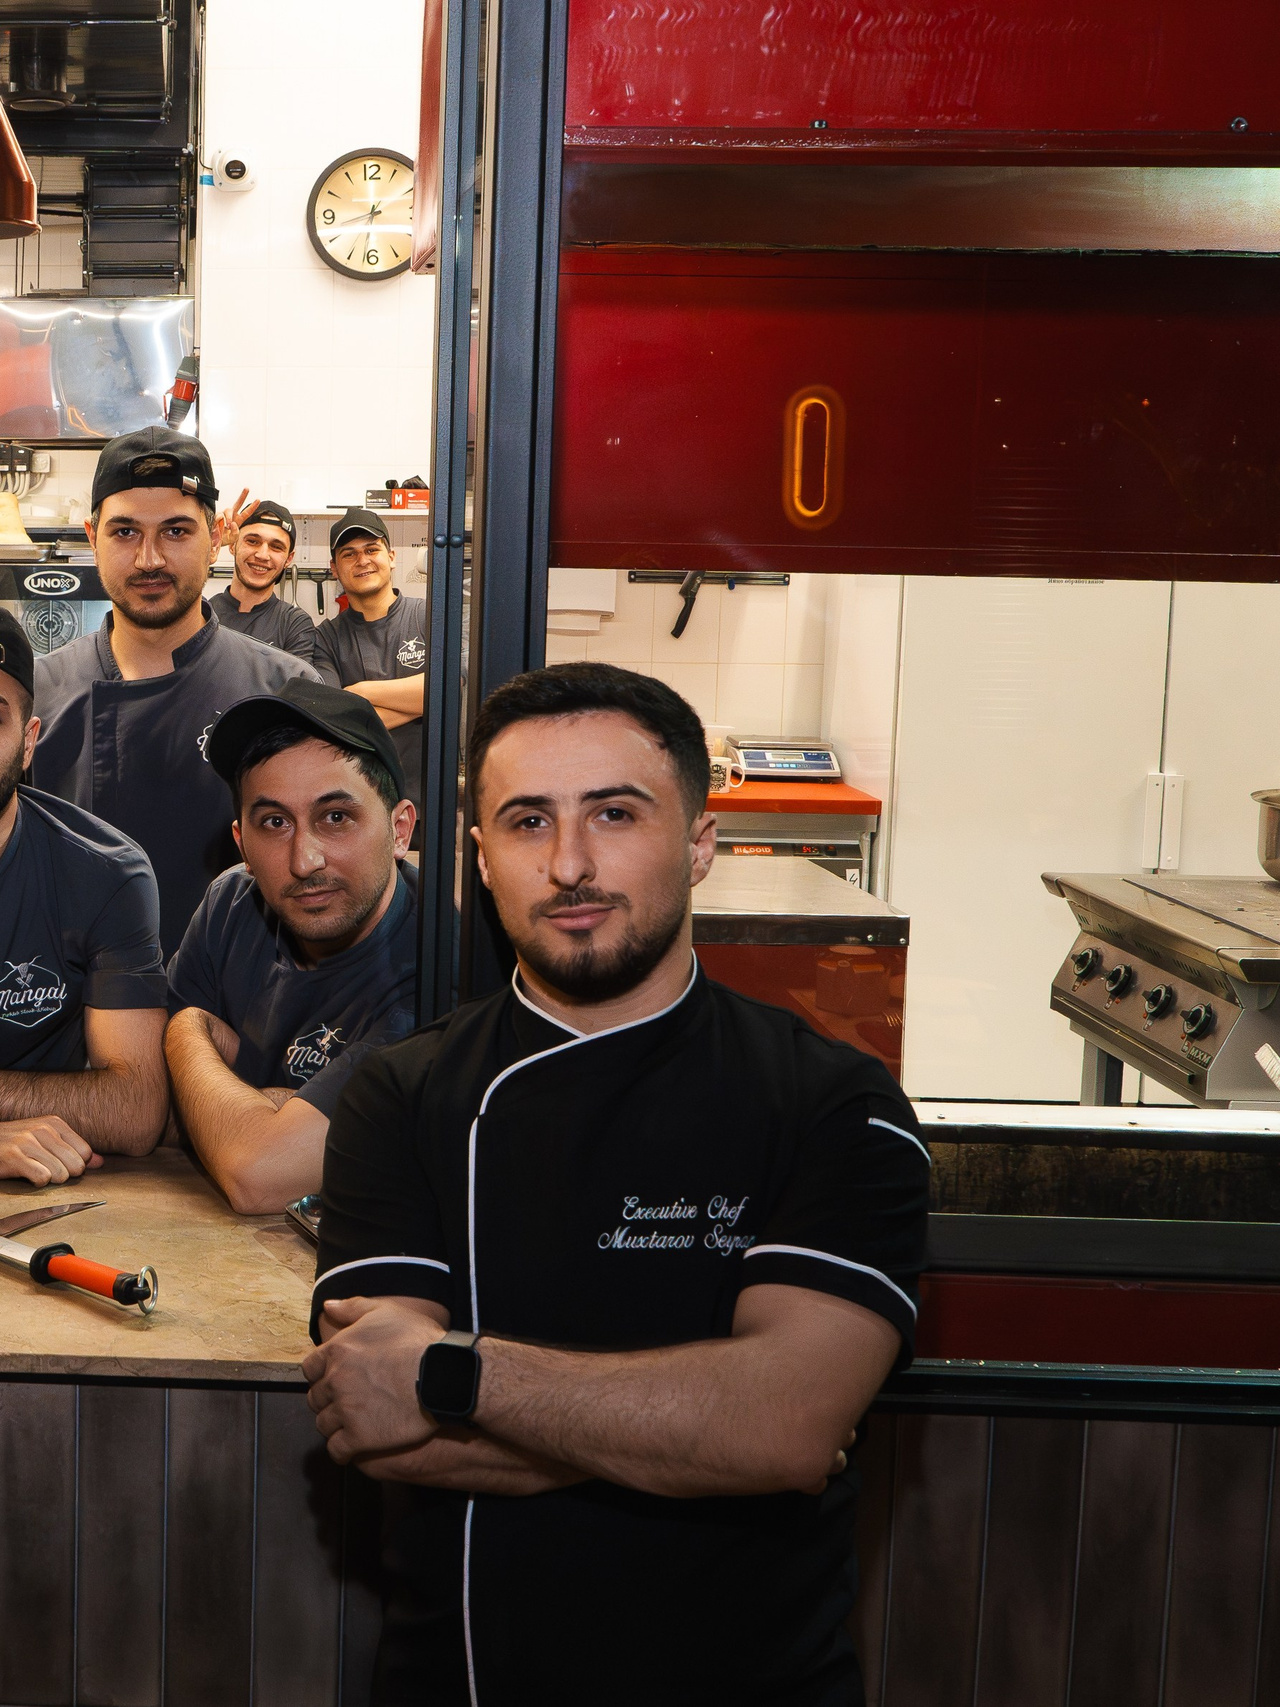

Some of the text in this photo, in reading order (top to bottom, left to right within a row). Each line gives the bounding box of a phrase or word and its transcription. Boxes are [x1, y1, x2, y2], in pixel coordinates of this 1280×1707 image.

[362, 163, 381, 181] 12
[322, 208, 336, 225] 9
[366, 248, 379, 266] 6
[394, 493, 403, 506] M
[30, 577, 71, 589] UNOX
[622, 1195, 750, 1227] Executive Chef
[597, 1225, 695, 1249] Muxtarov
